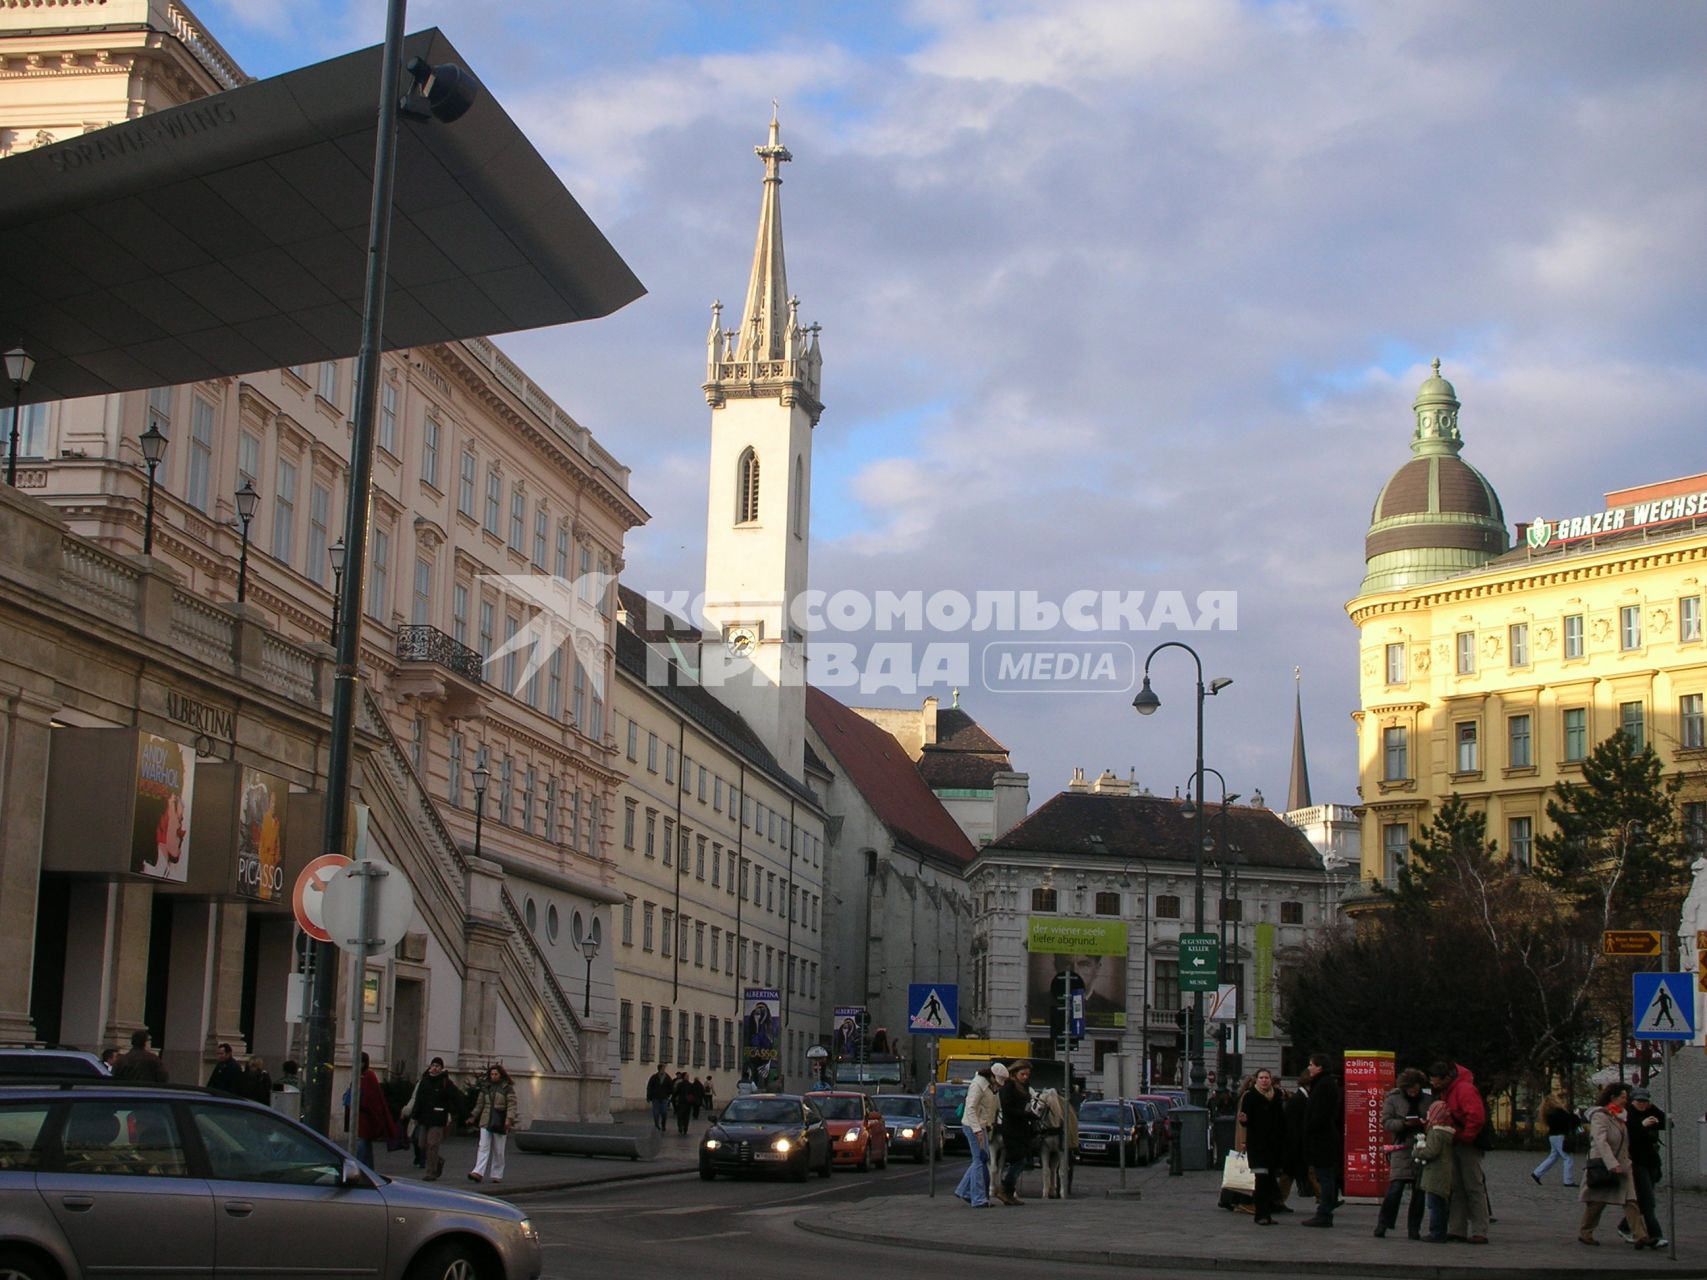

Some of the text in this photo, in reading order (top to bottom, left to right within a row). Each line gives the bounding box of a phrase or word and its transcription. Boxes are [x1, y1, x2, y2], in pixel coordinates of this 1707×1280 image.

[1558, 493, 1707, 540] GRAZER WECHSE
[167, 691, 234, 739] ALBERTINA
[142, 743, 168, 769] ANDY
[141, 761, 179, 788] WARHOL
[238, 858, 283, 890] PICASSO
[1033, 921, 1106, 936] der wiener seele
[1057, 935, 1098, 946] abgrund.
[745, 990, 779, 999] ALBERTINA
